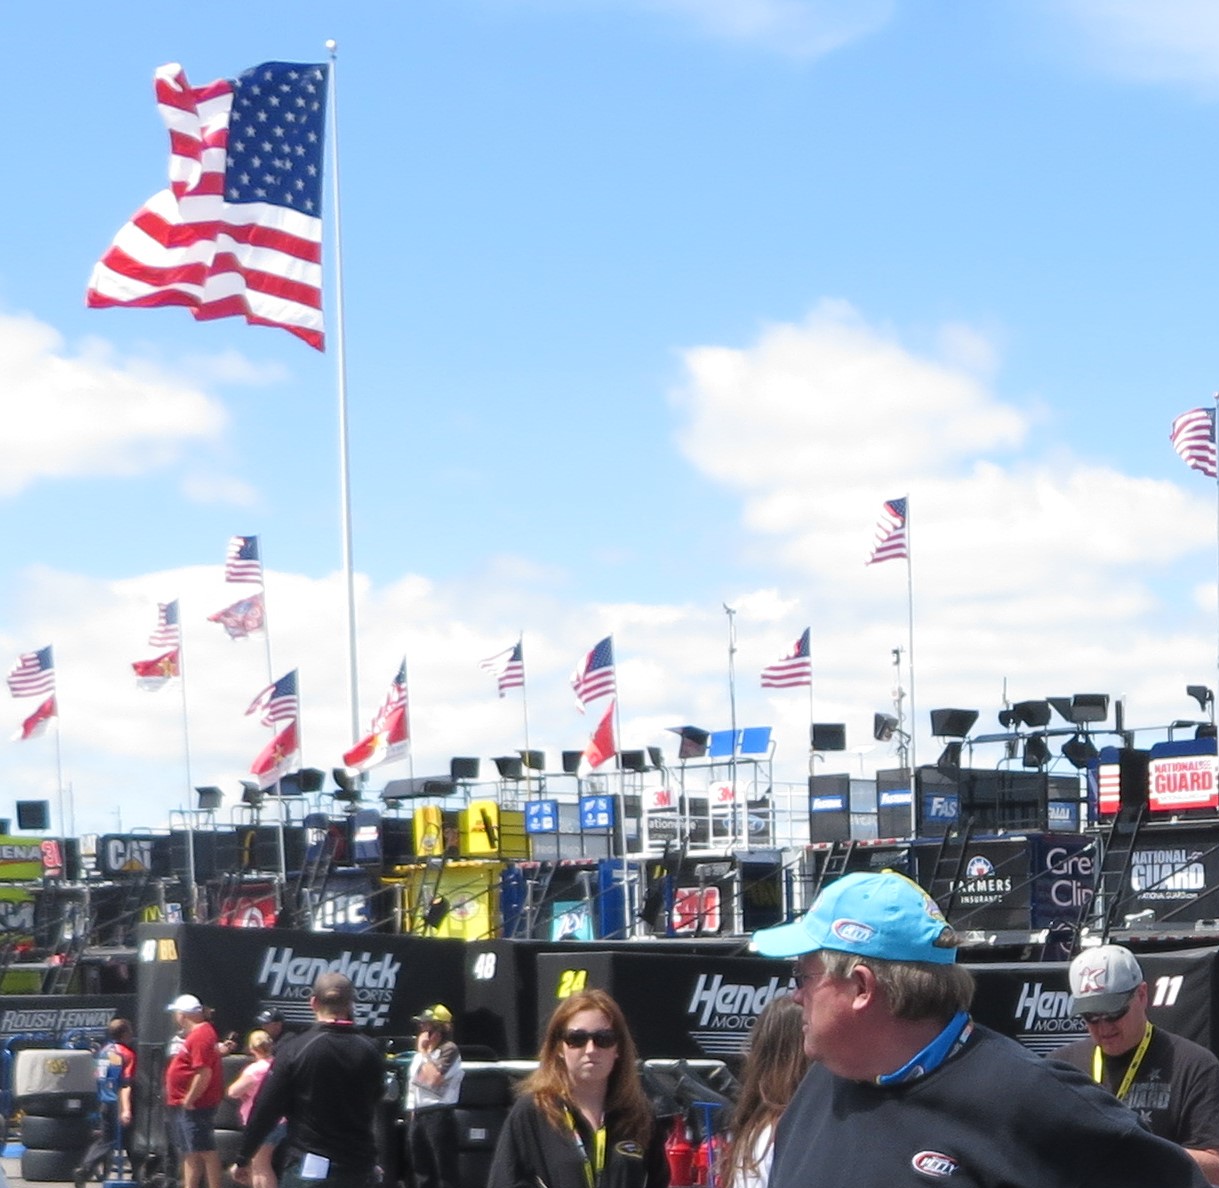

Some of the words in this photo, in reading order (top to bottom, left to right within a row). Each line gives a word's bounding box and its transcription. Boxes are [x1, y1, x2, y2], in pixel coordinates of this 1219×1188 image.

[1154, 761, 1201, 773] NATIONAL
[1154, 771, 1213, 793] GUARD
[653, 790, 671, 807] 3M
[108, 838, 155, 871] CAT
[1131, 849, 1188, 866] NATIONAL
[1131, 861, 1207, 892] GUARD
[258, 946, 402, 997] Hendrick
[474, 952, 497, 979] 48
[555, 968, 589, 998] 24
[1080, 966, 1106, 994] K
[1152, 975, 1184, 1007] 11
[1, 1009, 58, 1032] ROUSH
[57, 1008, 116, 1033] FENWAY
[711, 1014, 755, 1030] MOTO
[1035, 1018, 1088, 1032] MOTORS
